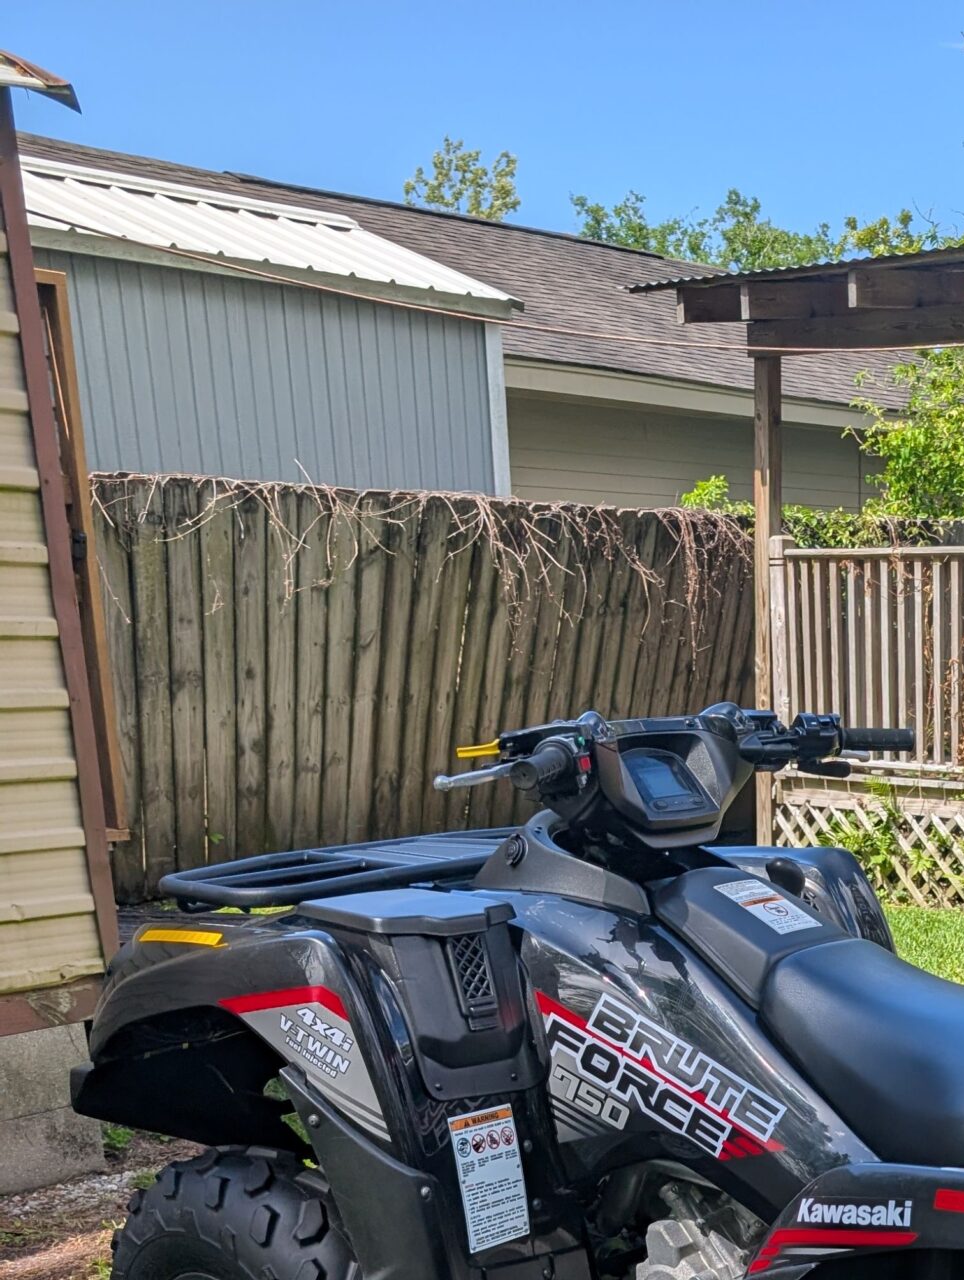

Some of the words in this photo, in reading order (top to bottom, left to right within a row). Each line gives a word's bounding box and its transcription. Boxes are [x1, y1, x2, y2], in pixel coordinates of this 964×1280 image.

[280, 1012, 351, 1076] V-TWIN
[297, 1007, 354, 1052] 4x4i
[546, 1012, 732, 1158] FORCE
[553, 1064, 629, 1130] 750
[585, 993, 787, 1142] BRUTE
[471, 1111, 500, 1124] WARNING
[797, 1198, 912, 1227] Kawasaki
